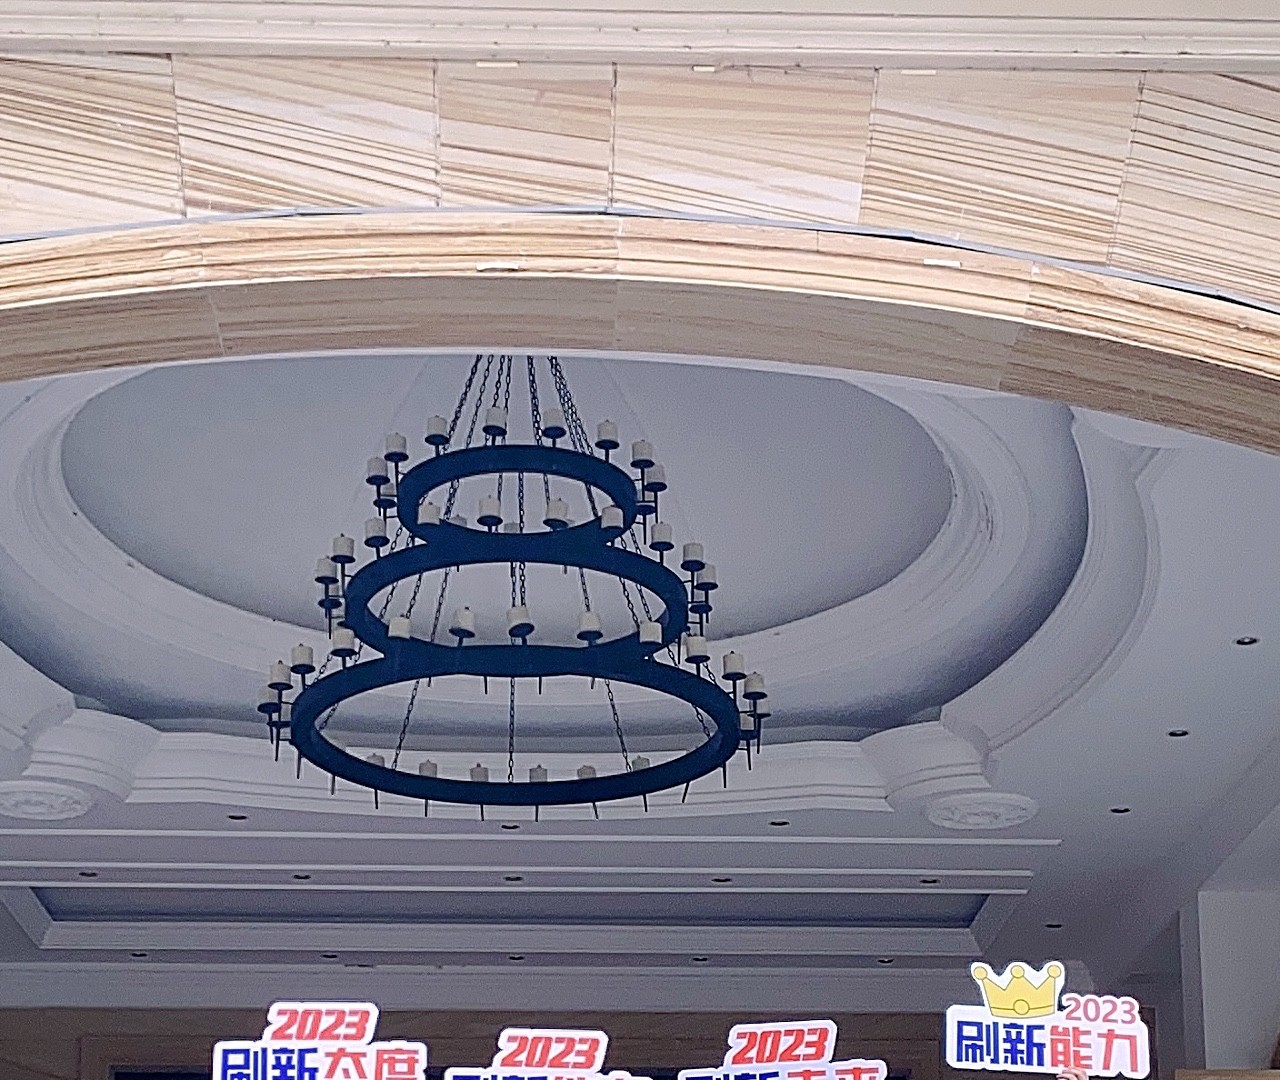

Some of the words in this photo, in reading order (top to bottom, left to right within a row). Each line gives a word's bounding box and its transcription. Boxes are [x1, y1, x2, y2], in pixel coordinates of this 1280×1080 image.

[270, 1009, 370, 1040] 2023
[1065, 998, 1137, 1025] 2023
[500, 1036, 600, 1068] 2023
[731, 1027, 829, 1065] 2023
[956, 1020, 1138, 1073] 刷新能力
